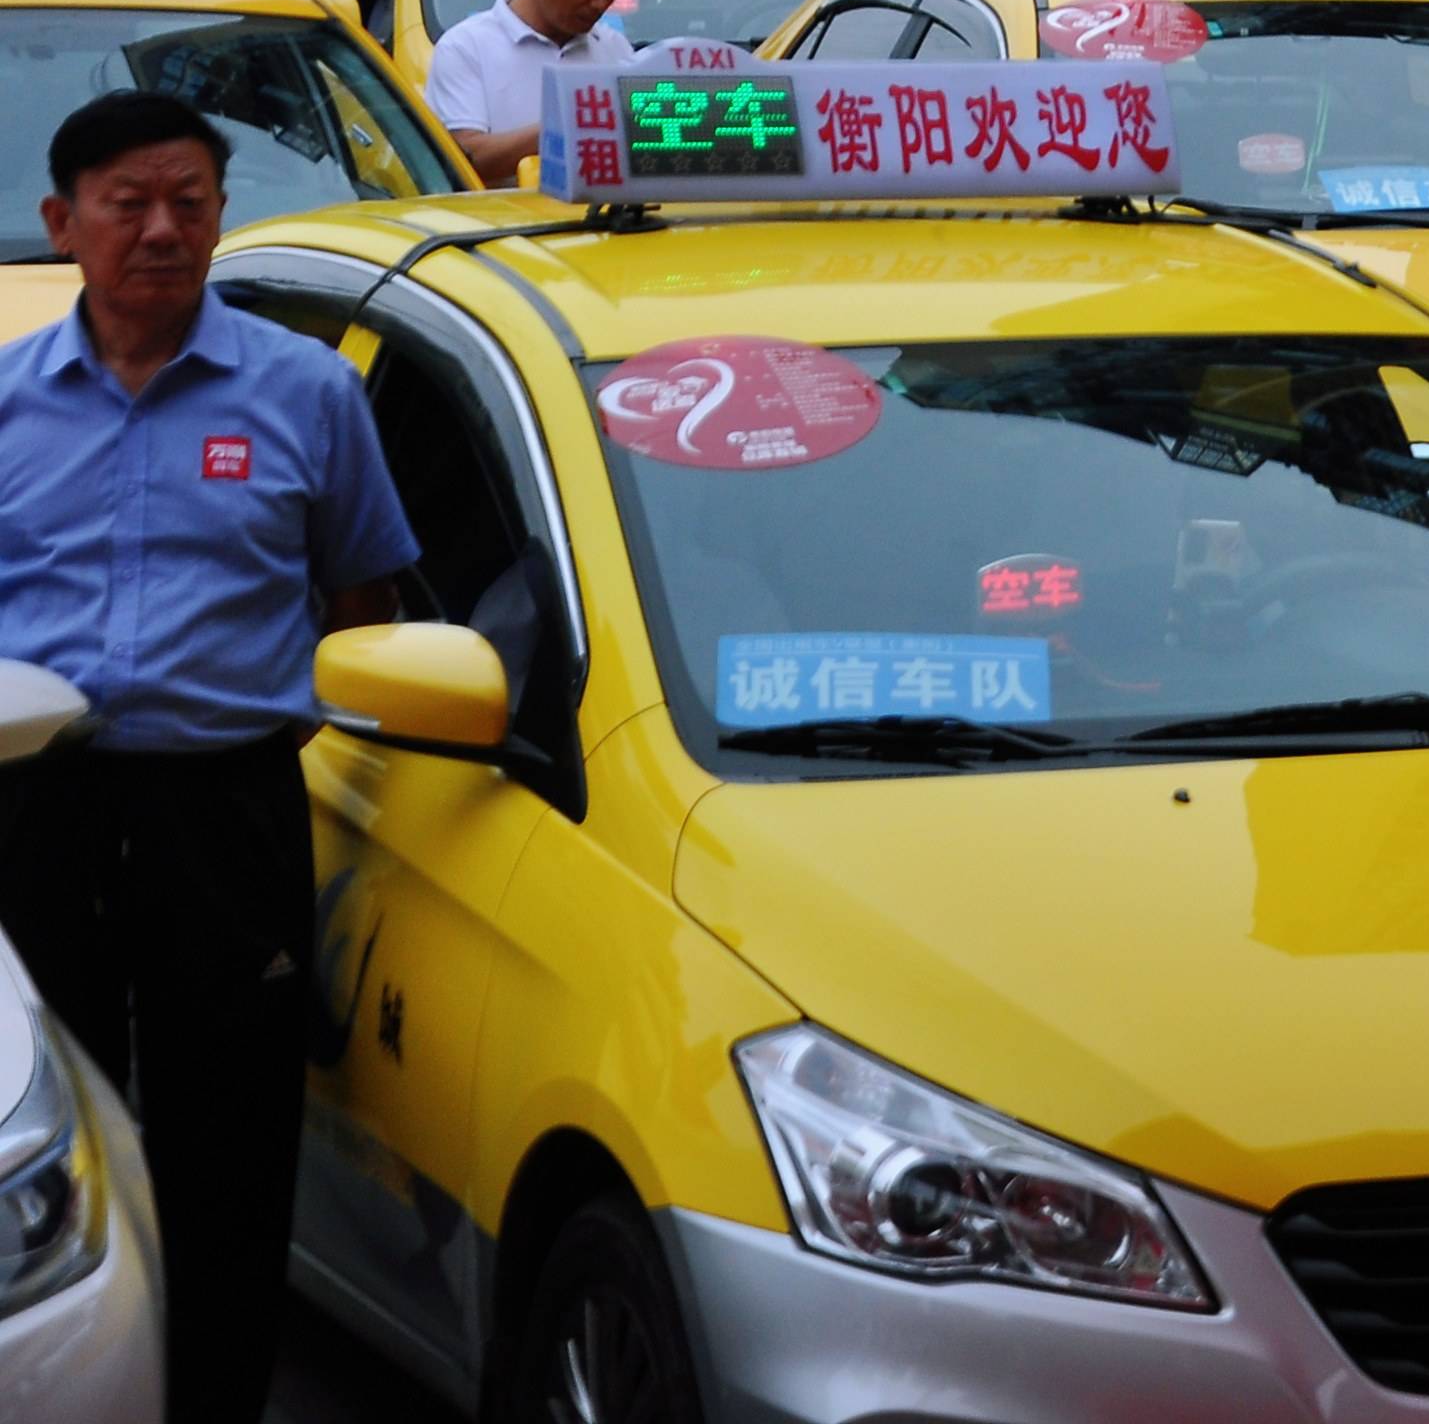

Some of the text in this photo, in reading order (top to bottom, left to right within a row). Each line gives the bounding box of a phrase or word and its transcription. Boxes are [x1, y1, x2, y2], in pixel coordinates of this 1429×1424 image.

[667, 46, 736, 70] TAXI
[575, 84, 624, 188] 出租
[630, 81, 796, 153] 空车
[815, 79, 1170, 175] 衡阳欢迎您
[980, 564, 1081, 613] 空车
[728, 656, 1038, 713] 诚信车队
